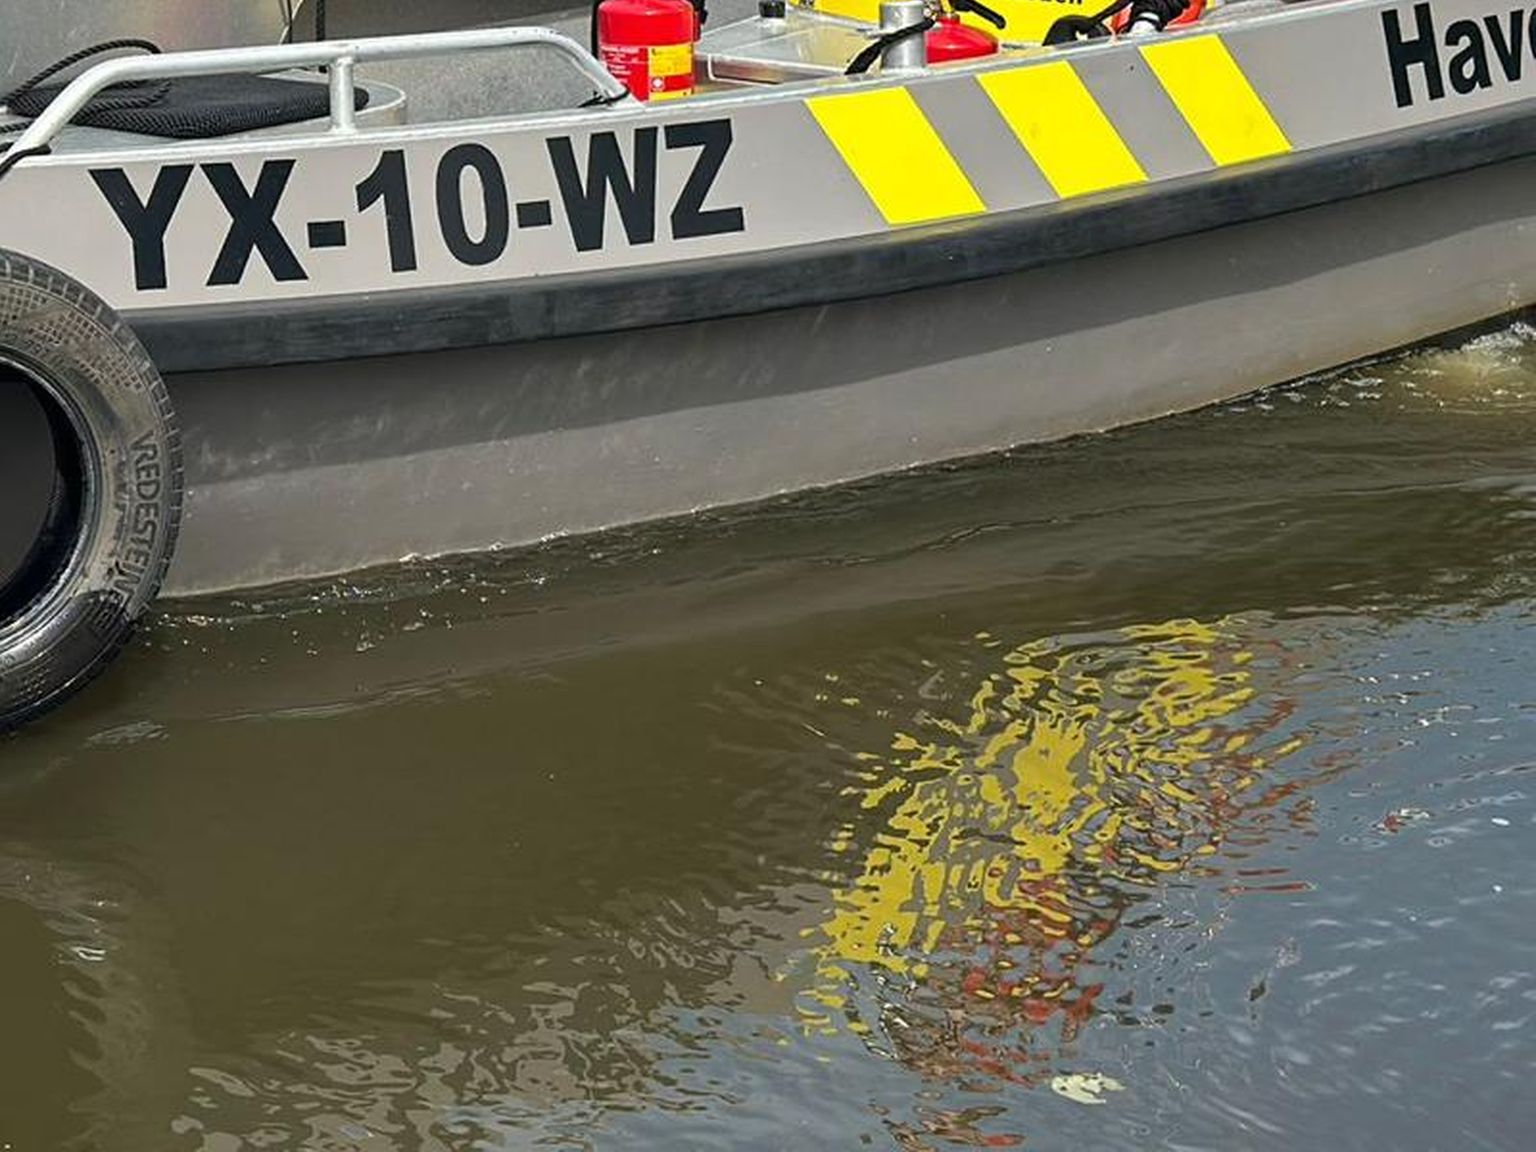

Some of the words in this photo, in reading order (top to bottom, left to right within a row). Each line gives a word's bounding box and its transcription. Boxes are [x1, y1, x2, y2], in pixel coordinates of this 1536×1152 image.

[1381, 2, 1536, 108] Hav
[89, 118, 746, 291] YX-10-WZ
[114, 429, 161, 595] VREDESTEIN
